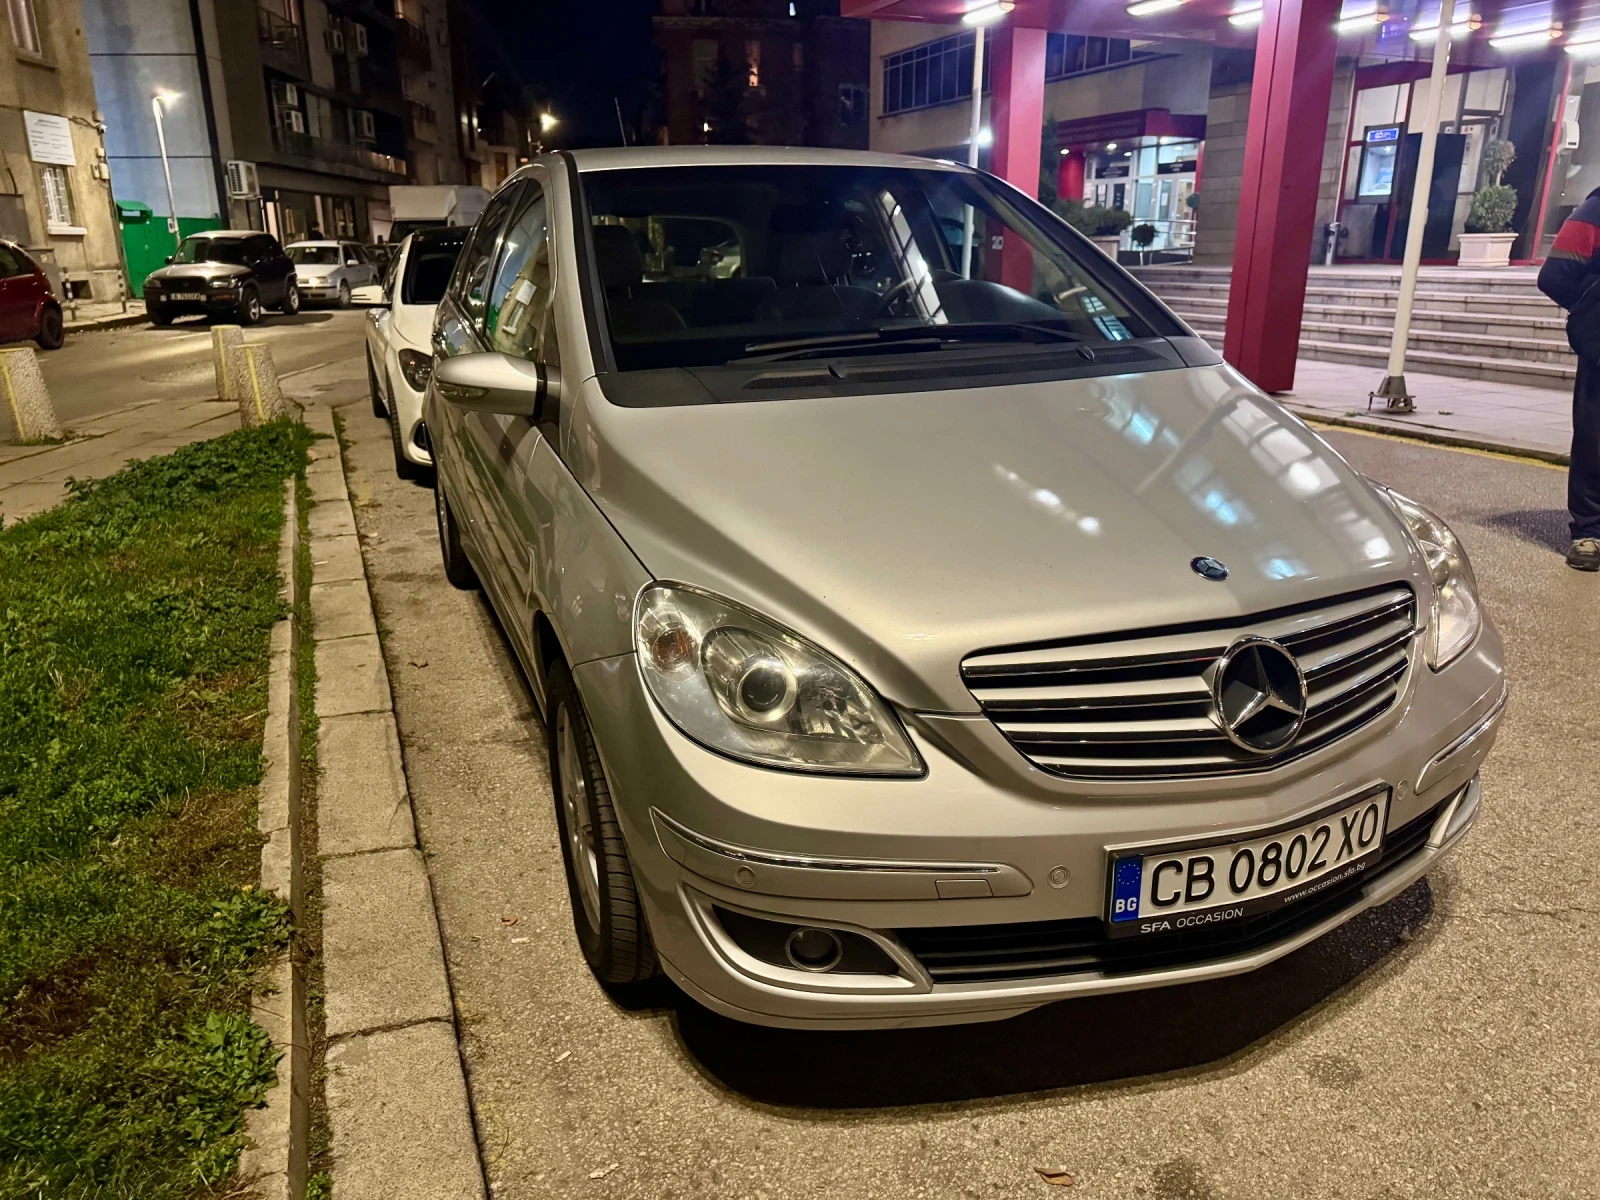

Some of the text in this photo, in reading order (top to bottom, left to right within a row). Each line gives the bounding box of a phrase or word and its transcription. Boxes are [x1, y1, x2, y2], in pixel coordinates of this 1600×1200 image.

[1150, 803, 1379, 908] CB 0802 XO
[1283, 861, 1366, 902] www.occasion.sfa.bg
[1115, 897, 1138, 913] BG
[1140, 907, 1244, 934] SFA OCCASION
